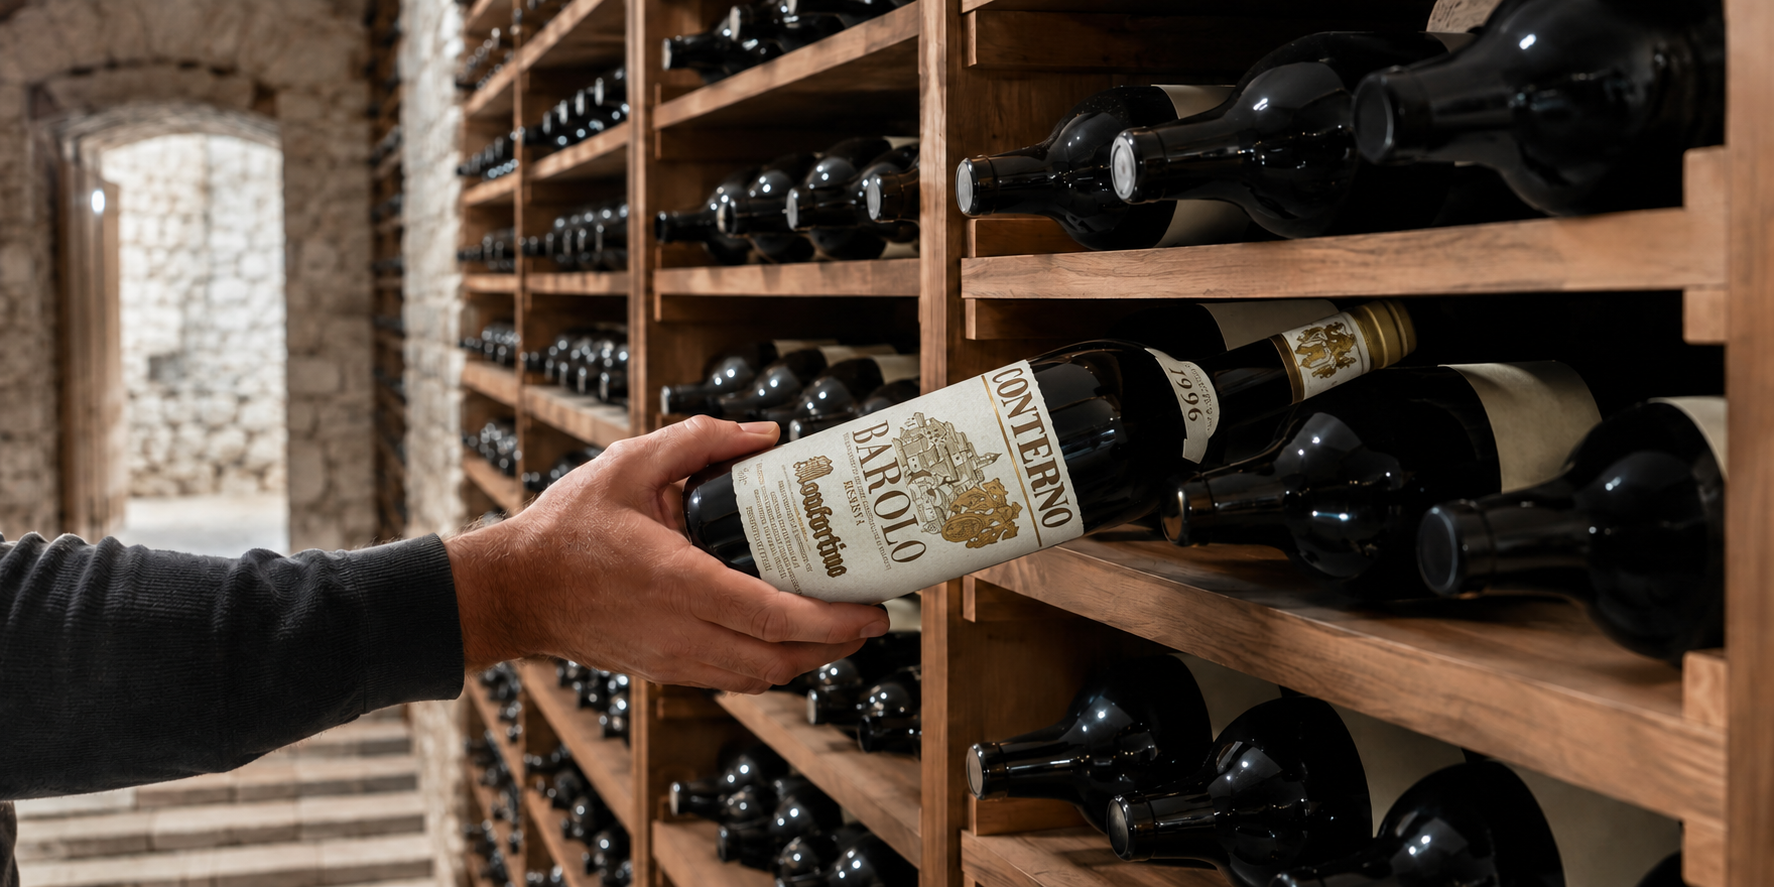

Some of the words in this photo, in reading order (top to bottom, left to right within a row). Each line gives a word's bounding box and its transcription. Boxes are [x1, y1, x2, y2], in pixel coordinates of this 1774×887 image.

[992, 367, 1073, 528] CONTERNO
[1168, 366, 1204, 422] 1996
[852, 420, 926, 563] BAROLO
